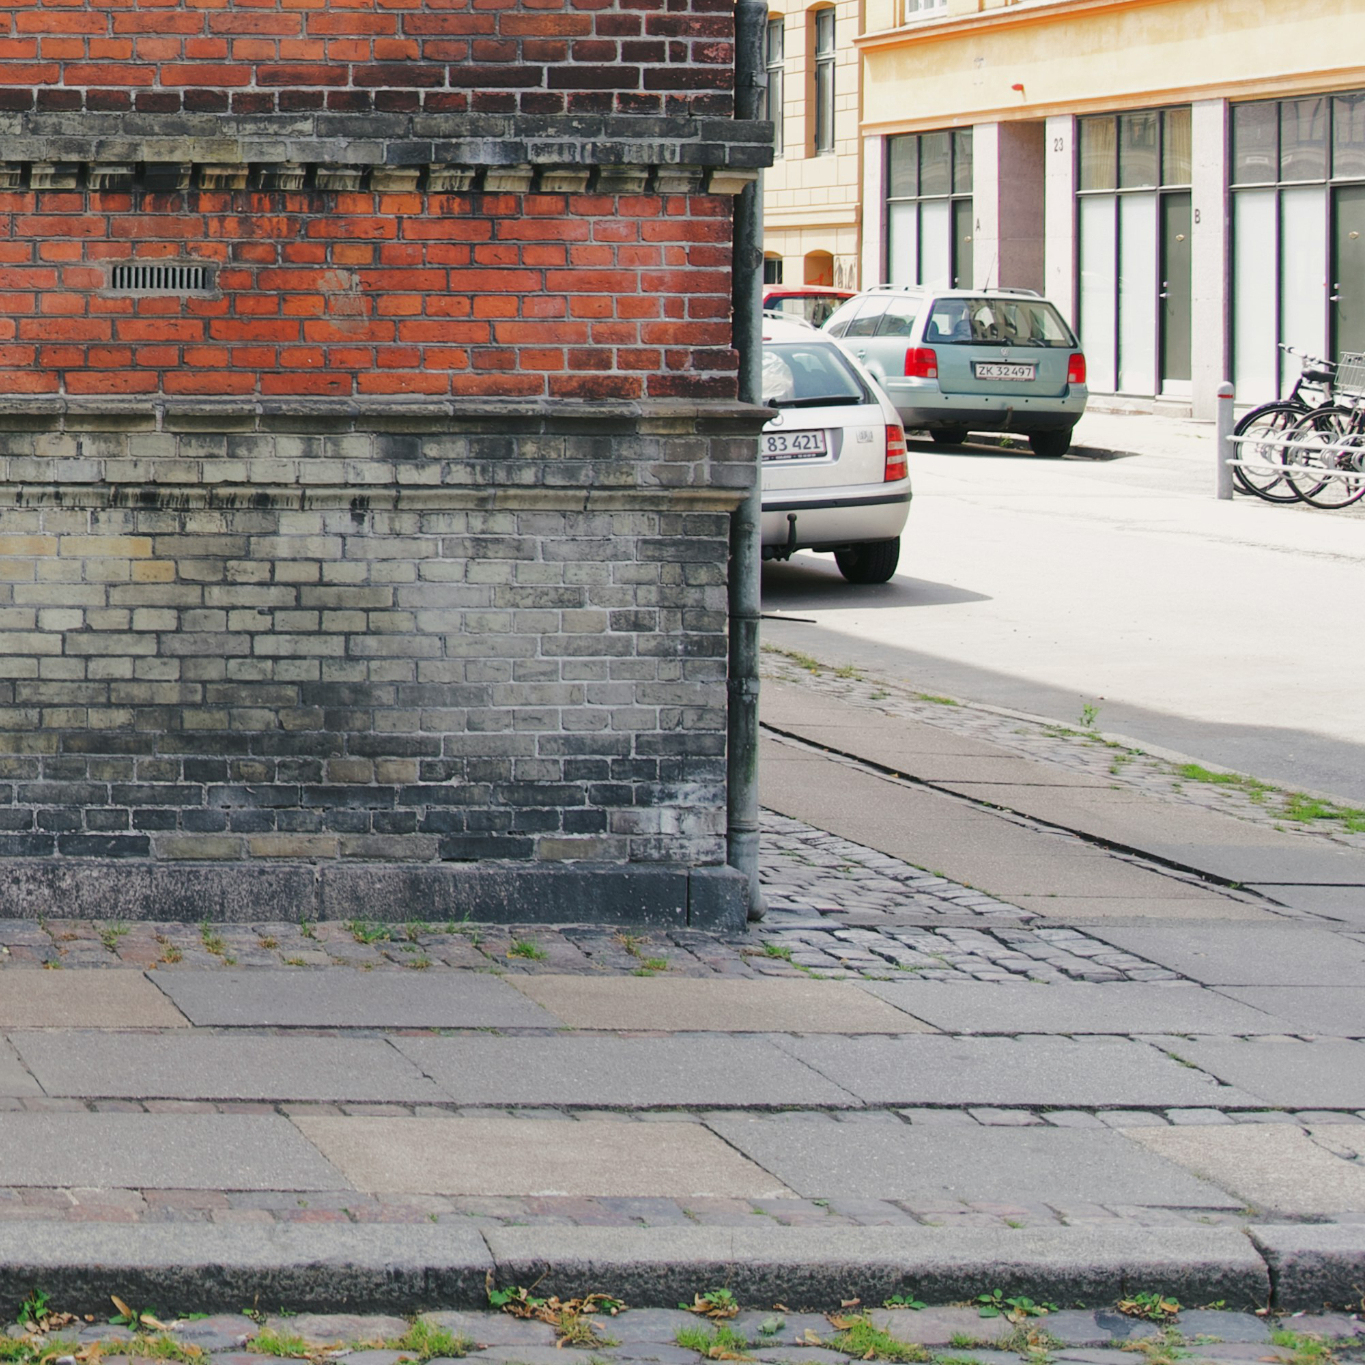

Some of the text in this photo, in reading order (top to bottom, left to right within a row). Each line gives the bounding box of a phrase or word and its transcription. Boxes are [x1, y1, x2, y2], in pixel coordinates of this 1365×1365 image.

[1053, 137, 1064, 152] 23
[978, 366, 994, 376] ZK
[767, 434, 821, 452] 83 421
